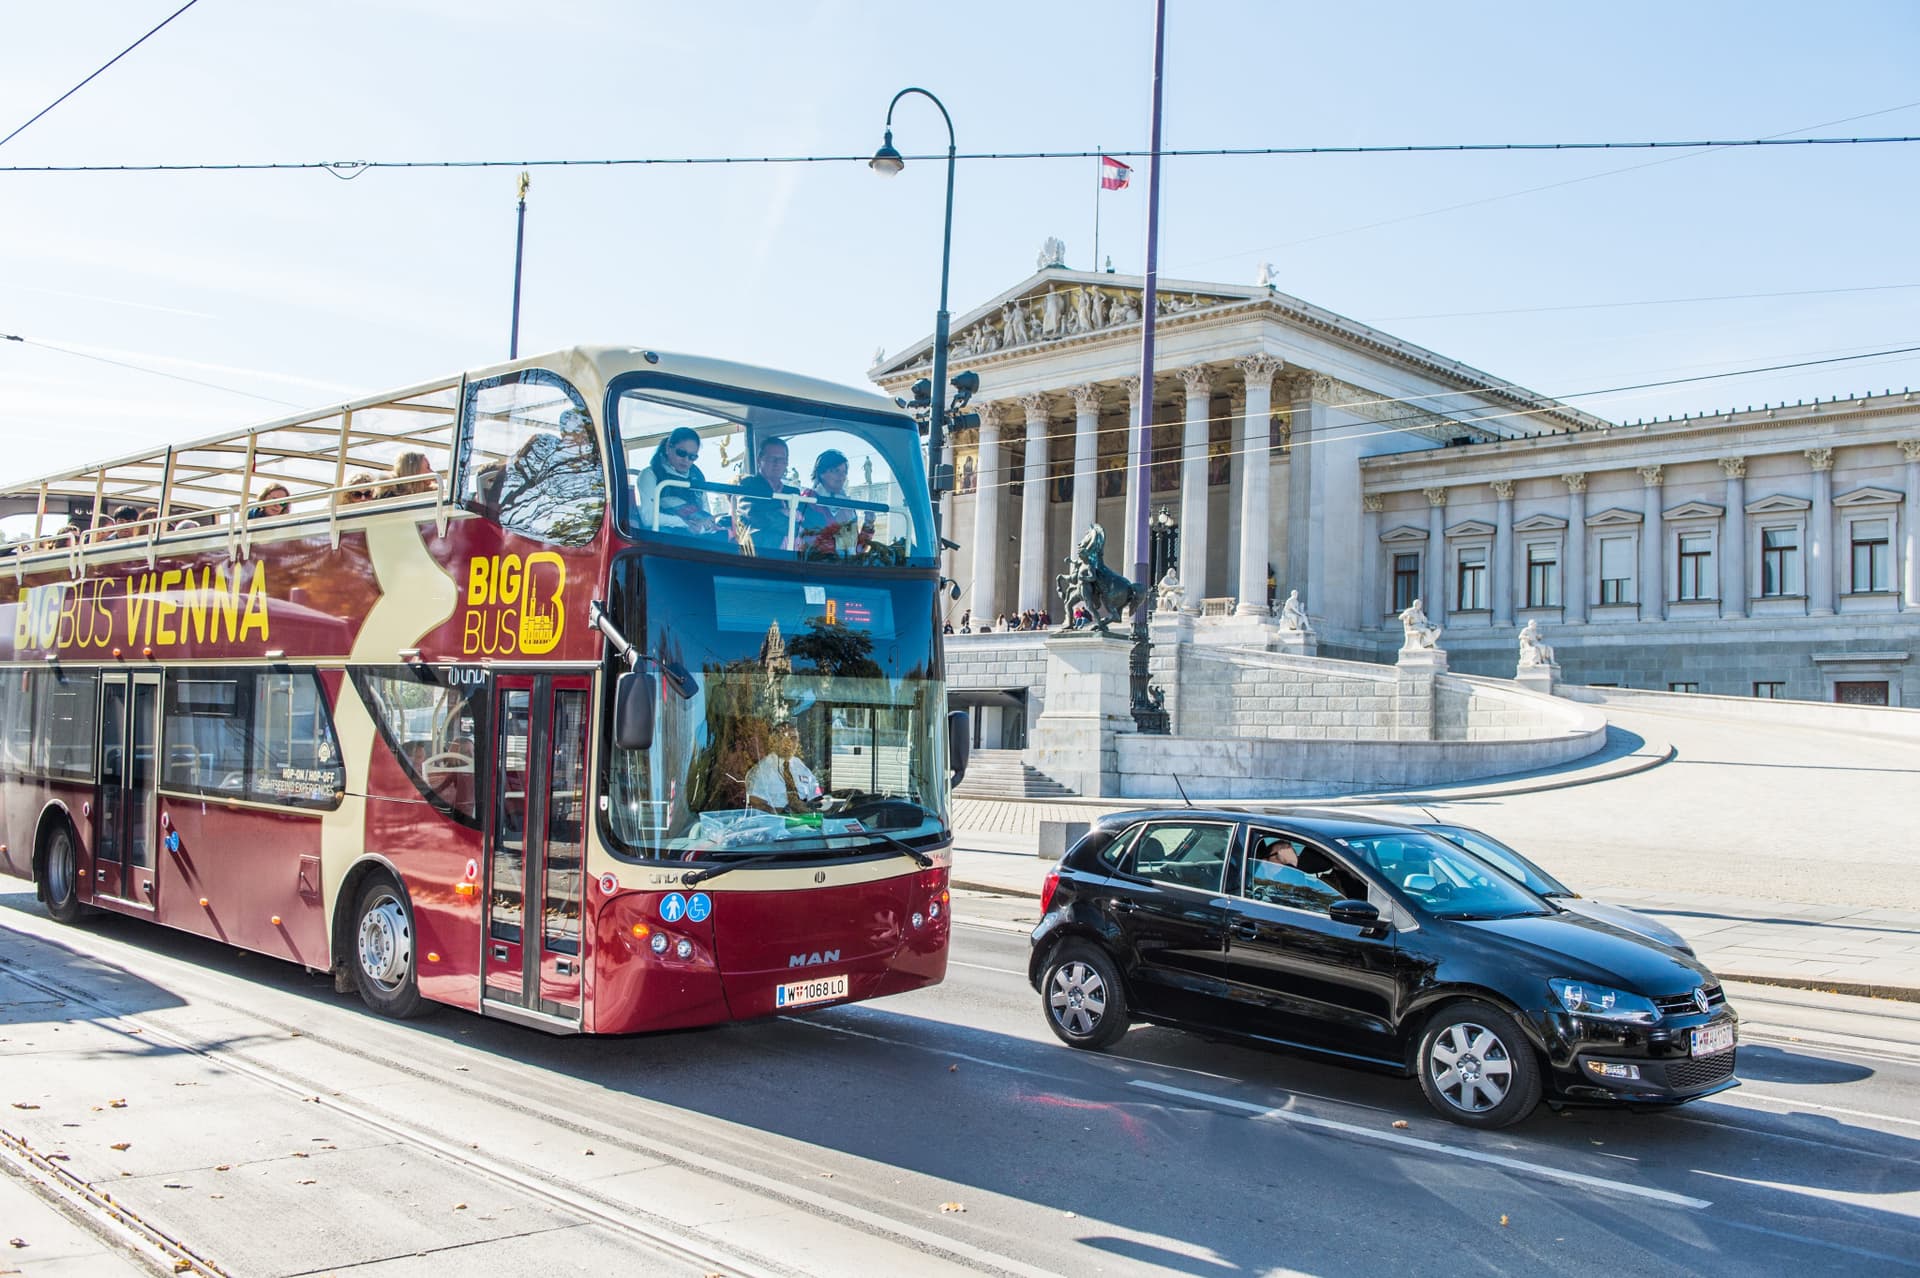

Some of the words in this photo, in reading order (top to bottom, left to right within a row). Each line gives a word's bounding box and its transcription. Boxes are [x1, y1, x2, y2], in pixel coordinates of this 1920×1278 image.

[126, 559, 270, 647] VIENNA
[467, 553, 522, 606] BIG
[463, 608, 518, 655] BUS
[788, 949, 841, 969] MAN
